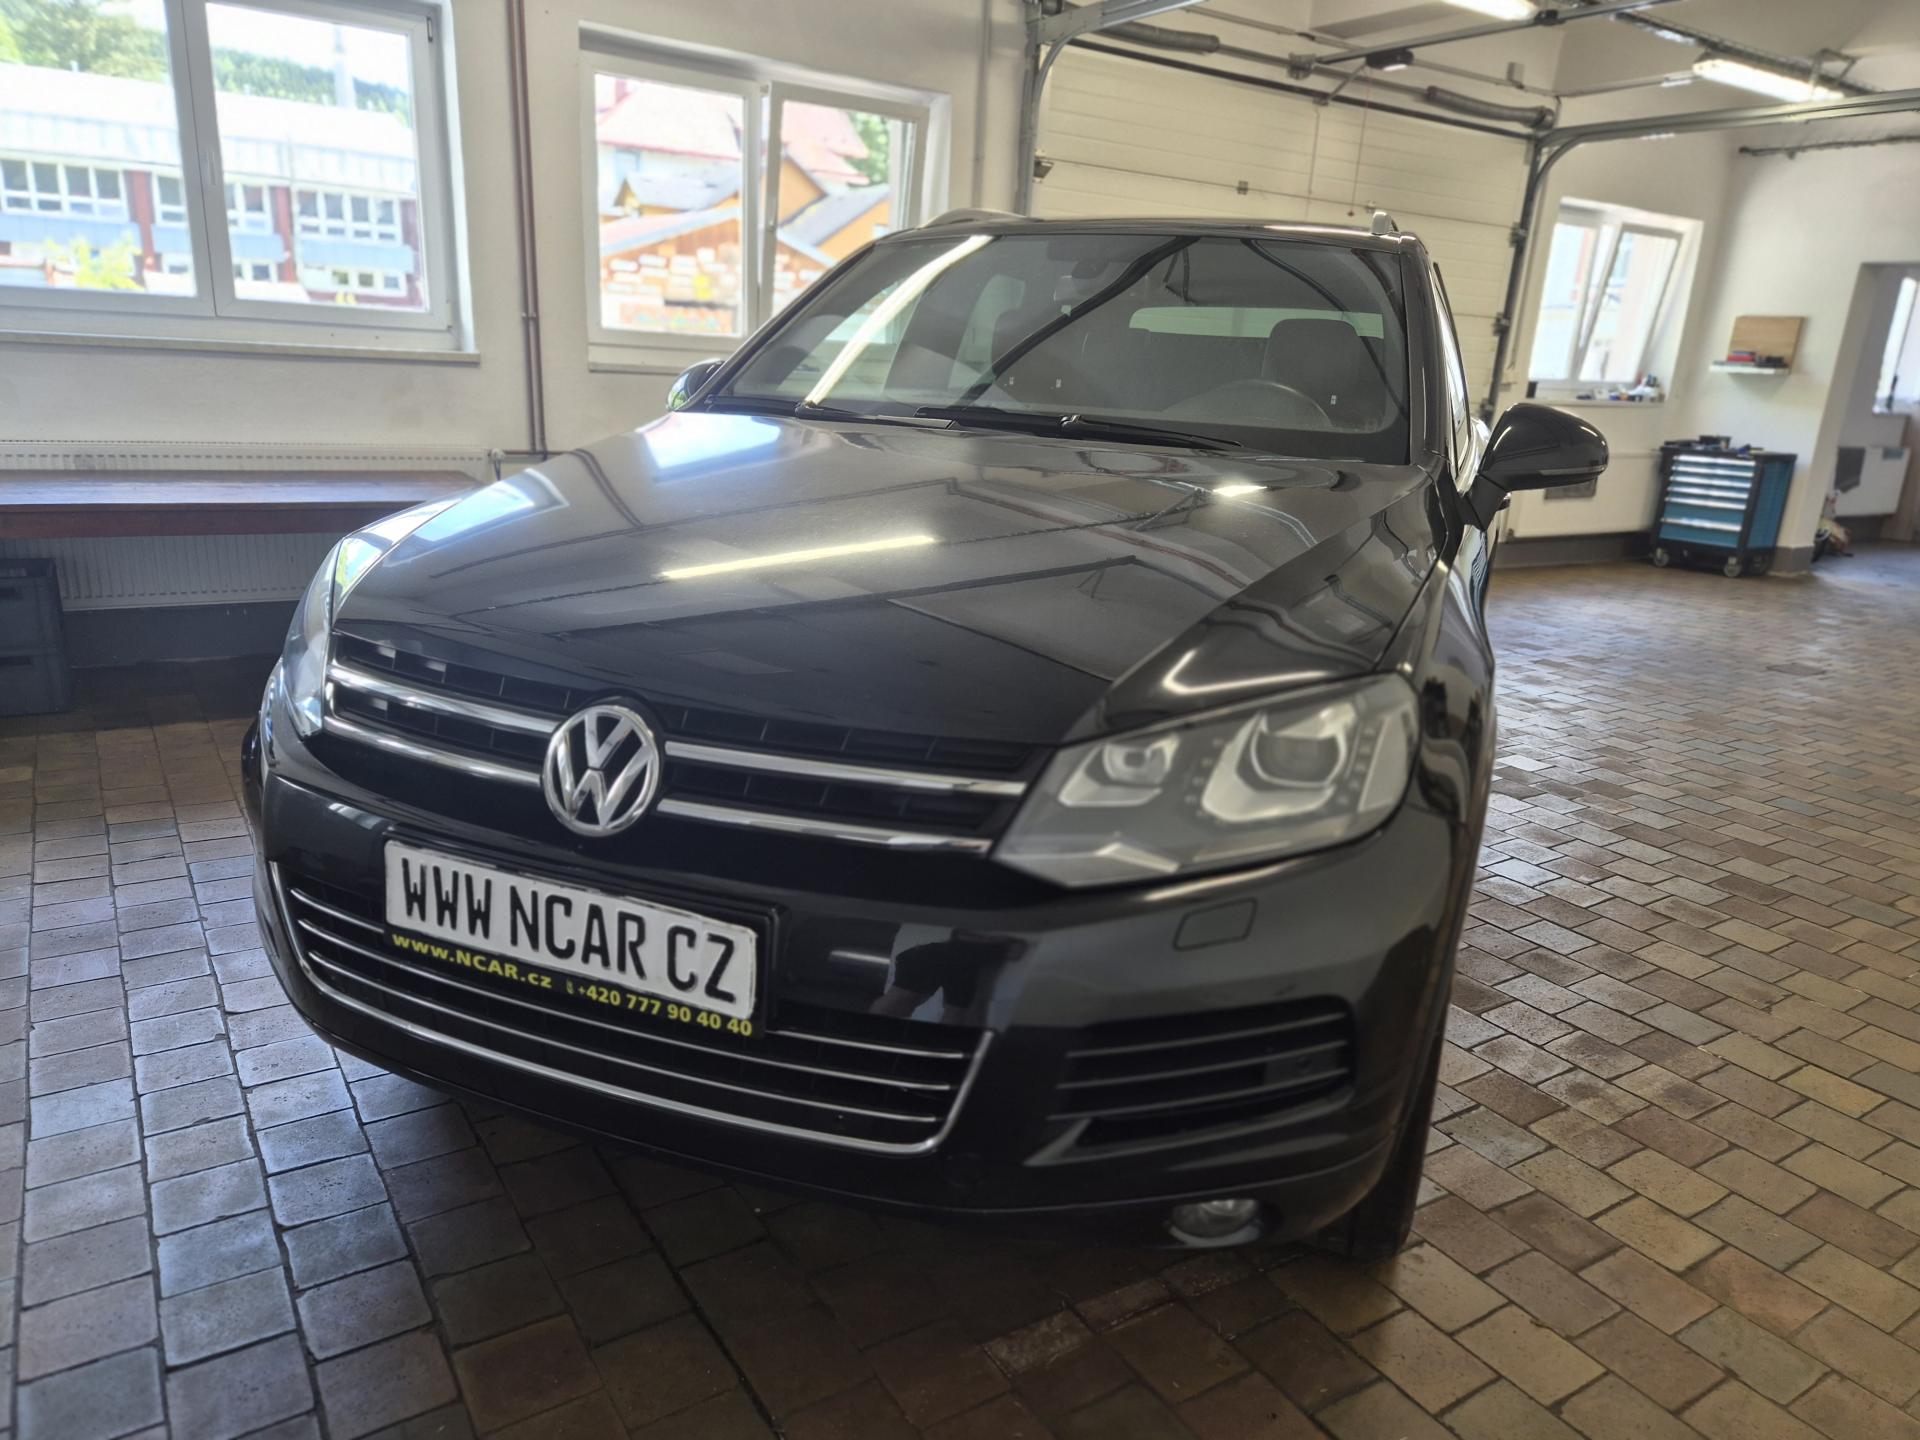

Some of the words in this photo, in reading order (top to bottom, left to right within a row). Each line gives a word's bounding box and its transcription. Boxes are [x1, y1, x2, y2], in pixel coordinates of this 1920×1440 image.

[545, 705, 658, 836] VW
[392, 933, 553, 989] www.NCAR.cz
[578, 985, 621, 1006] +420
[626, 993, 662, 1016] 777
[667, 1003, 692, 1023] 90
[697, 1011, 721, 1030] 40
[727, 1018, 752, 1037] 40
[402, 857, 492, 940] WWW
[509, 885, 647, 981] NCAR
[667, 925, 737, 1004] CZ
